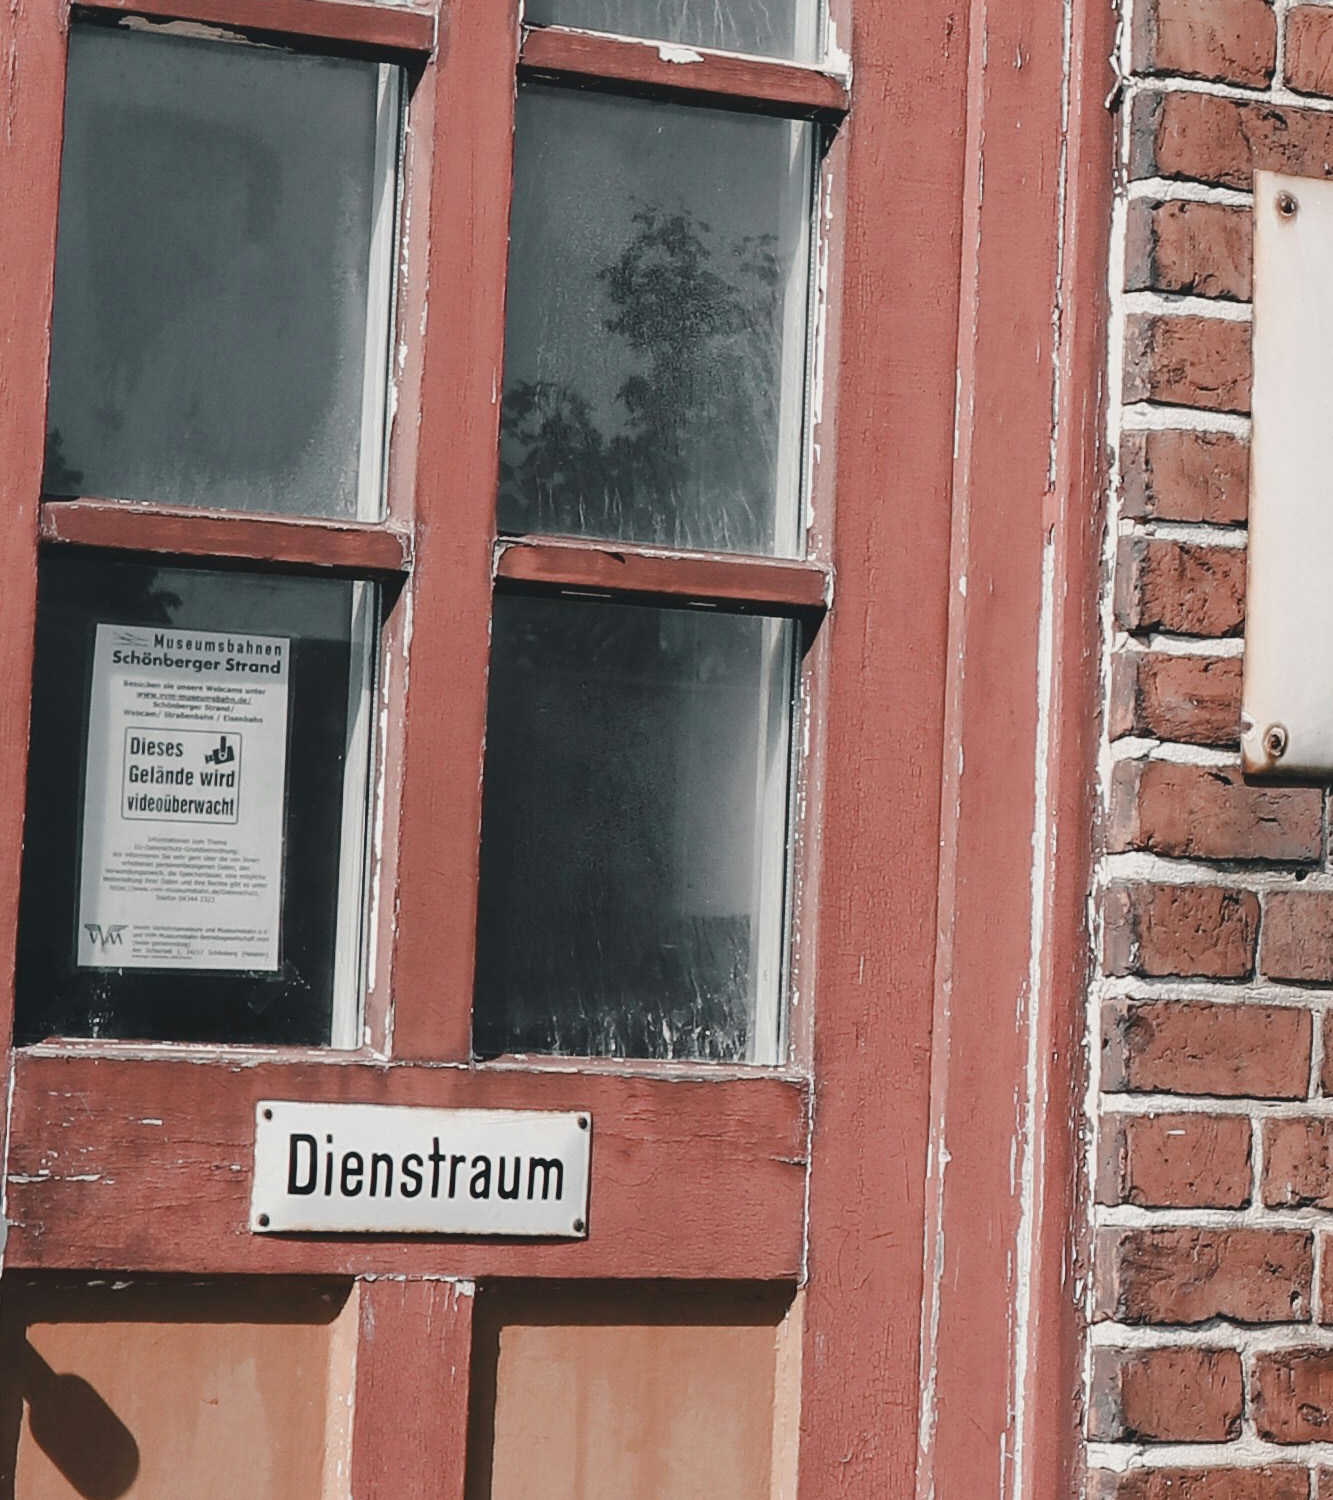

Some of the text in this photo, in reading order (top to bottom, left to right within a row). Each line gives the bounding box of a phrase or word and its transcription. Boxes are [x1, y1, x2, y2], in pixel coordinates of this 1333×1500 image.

[153, 633, 282, 656] Museumsbahnen
[112, 650, 281, 674] Schönberger Strand
[130, 737, 184, 757] Dieses
[129, 765, 236, 788] Gelände wird
[128, 793, 234, 816] videoüberwacht
[287, 1133, 564, 1200] Dienstraum
